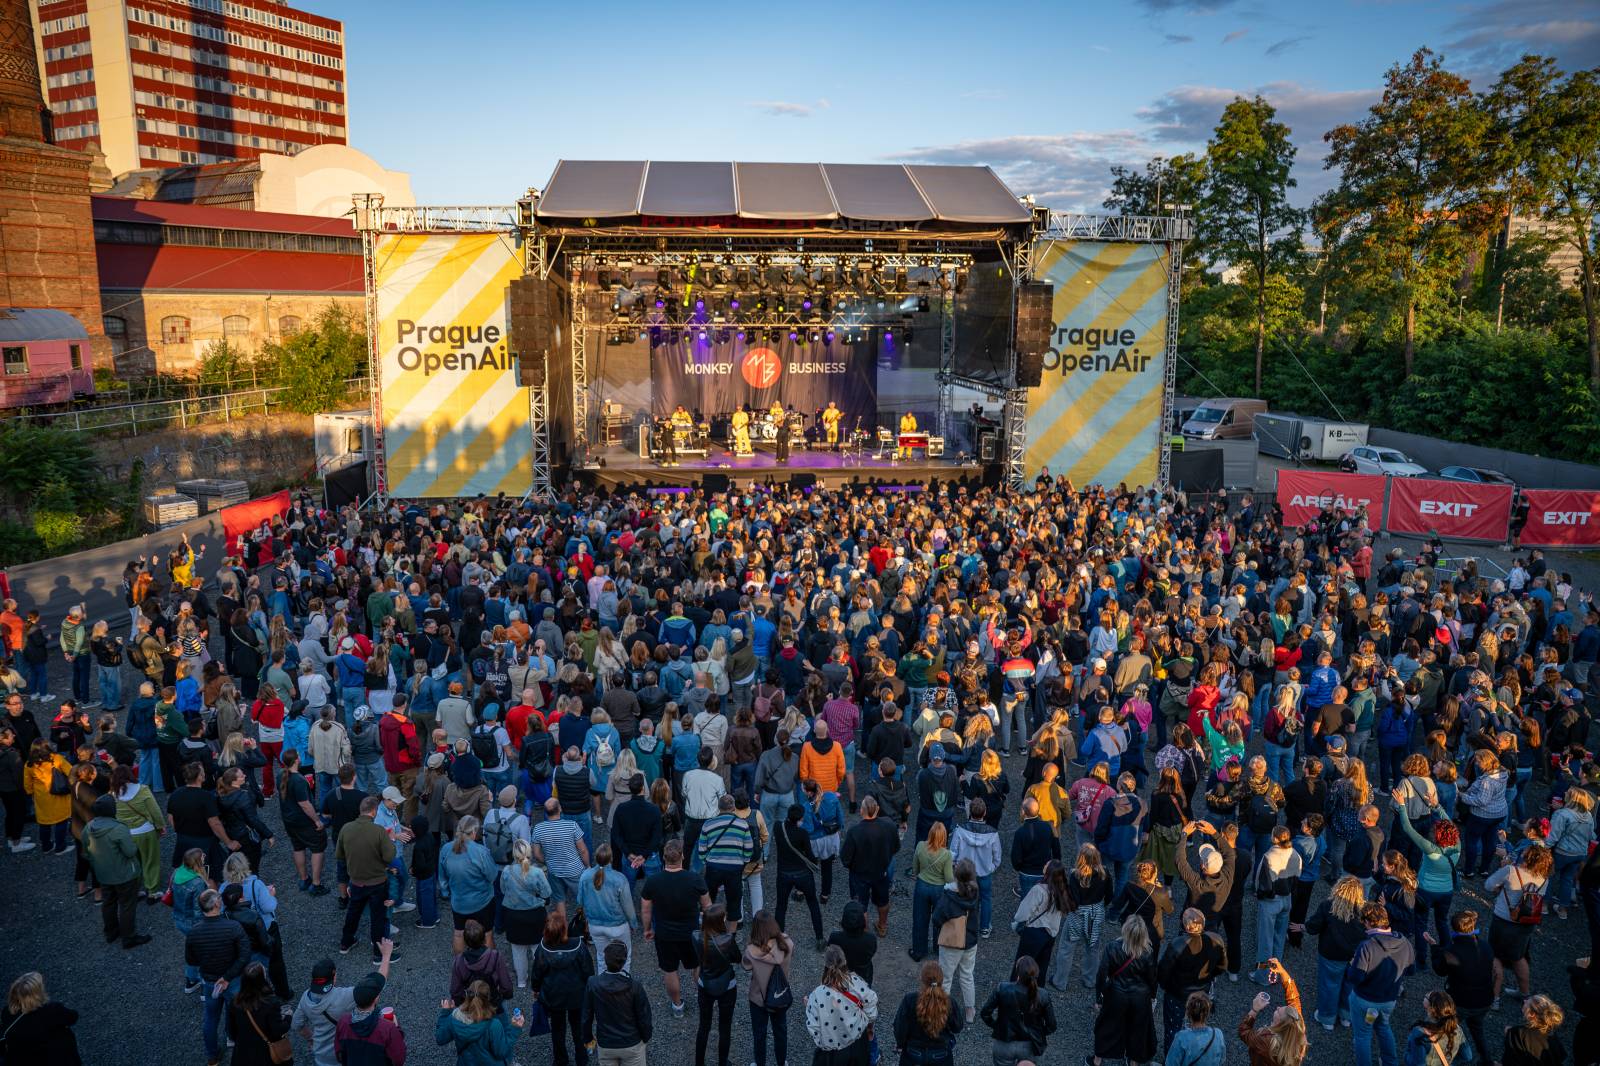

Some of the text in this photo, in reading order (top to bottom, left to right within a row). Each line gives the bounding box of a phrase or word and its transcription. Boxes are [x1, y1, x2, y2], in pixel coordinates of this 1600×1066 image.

[397, 319, 500, 349] Prague
[397, 346, 517, 376] OpenAir
[685, 362, 733, 375] MONKEY
[789, 362, 846, 374] BUSINESS
[1042, 347, 1151, 376] OpenAir
[1419, 500, 1478, 517] EXIT
[1543, 511, 1592, 525] EXIT
